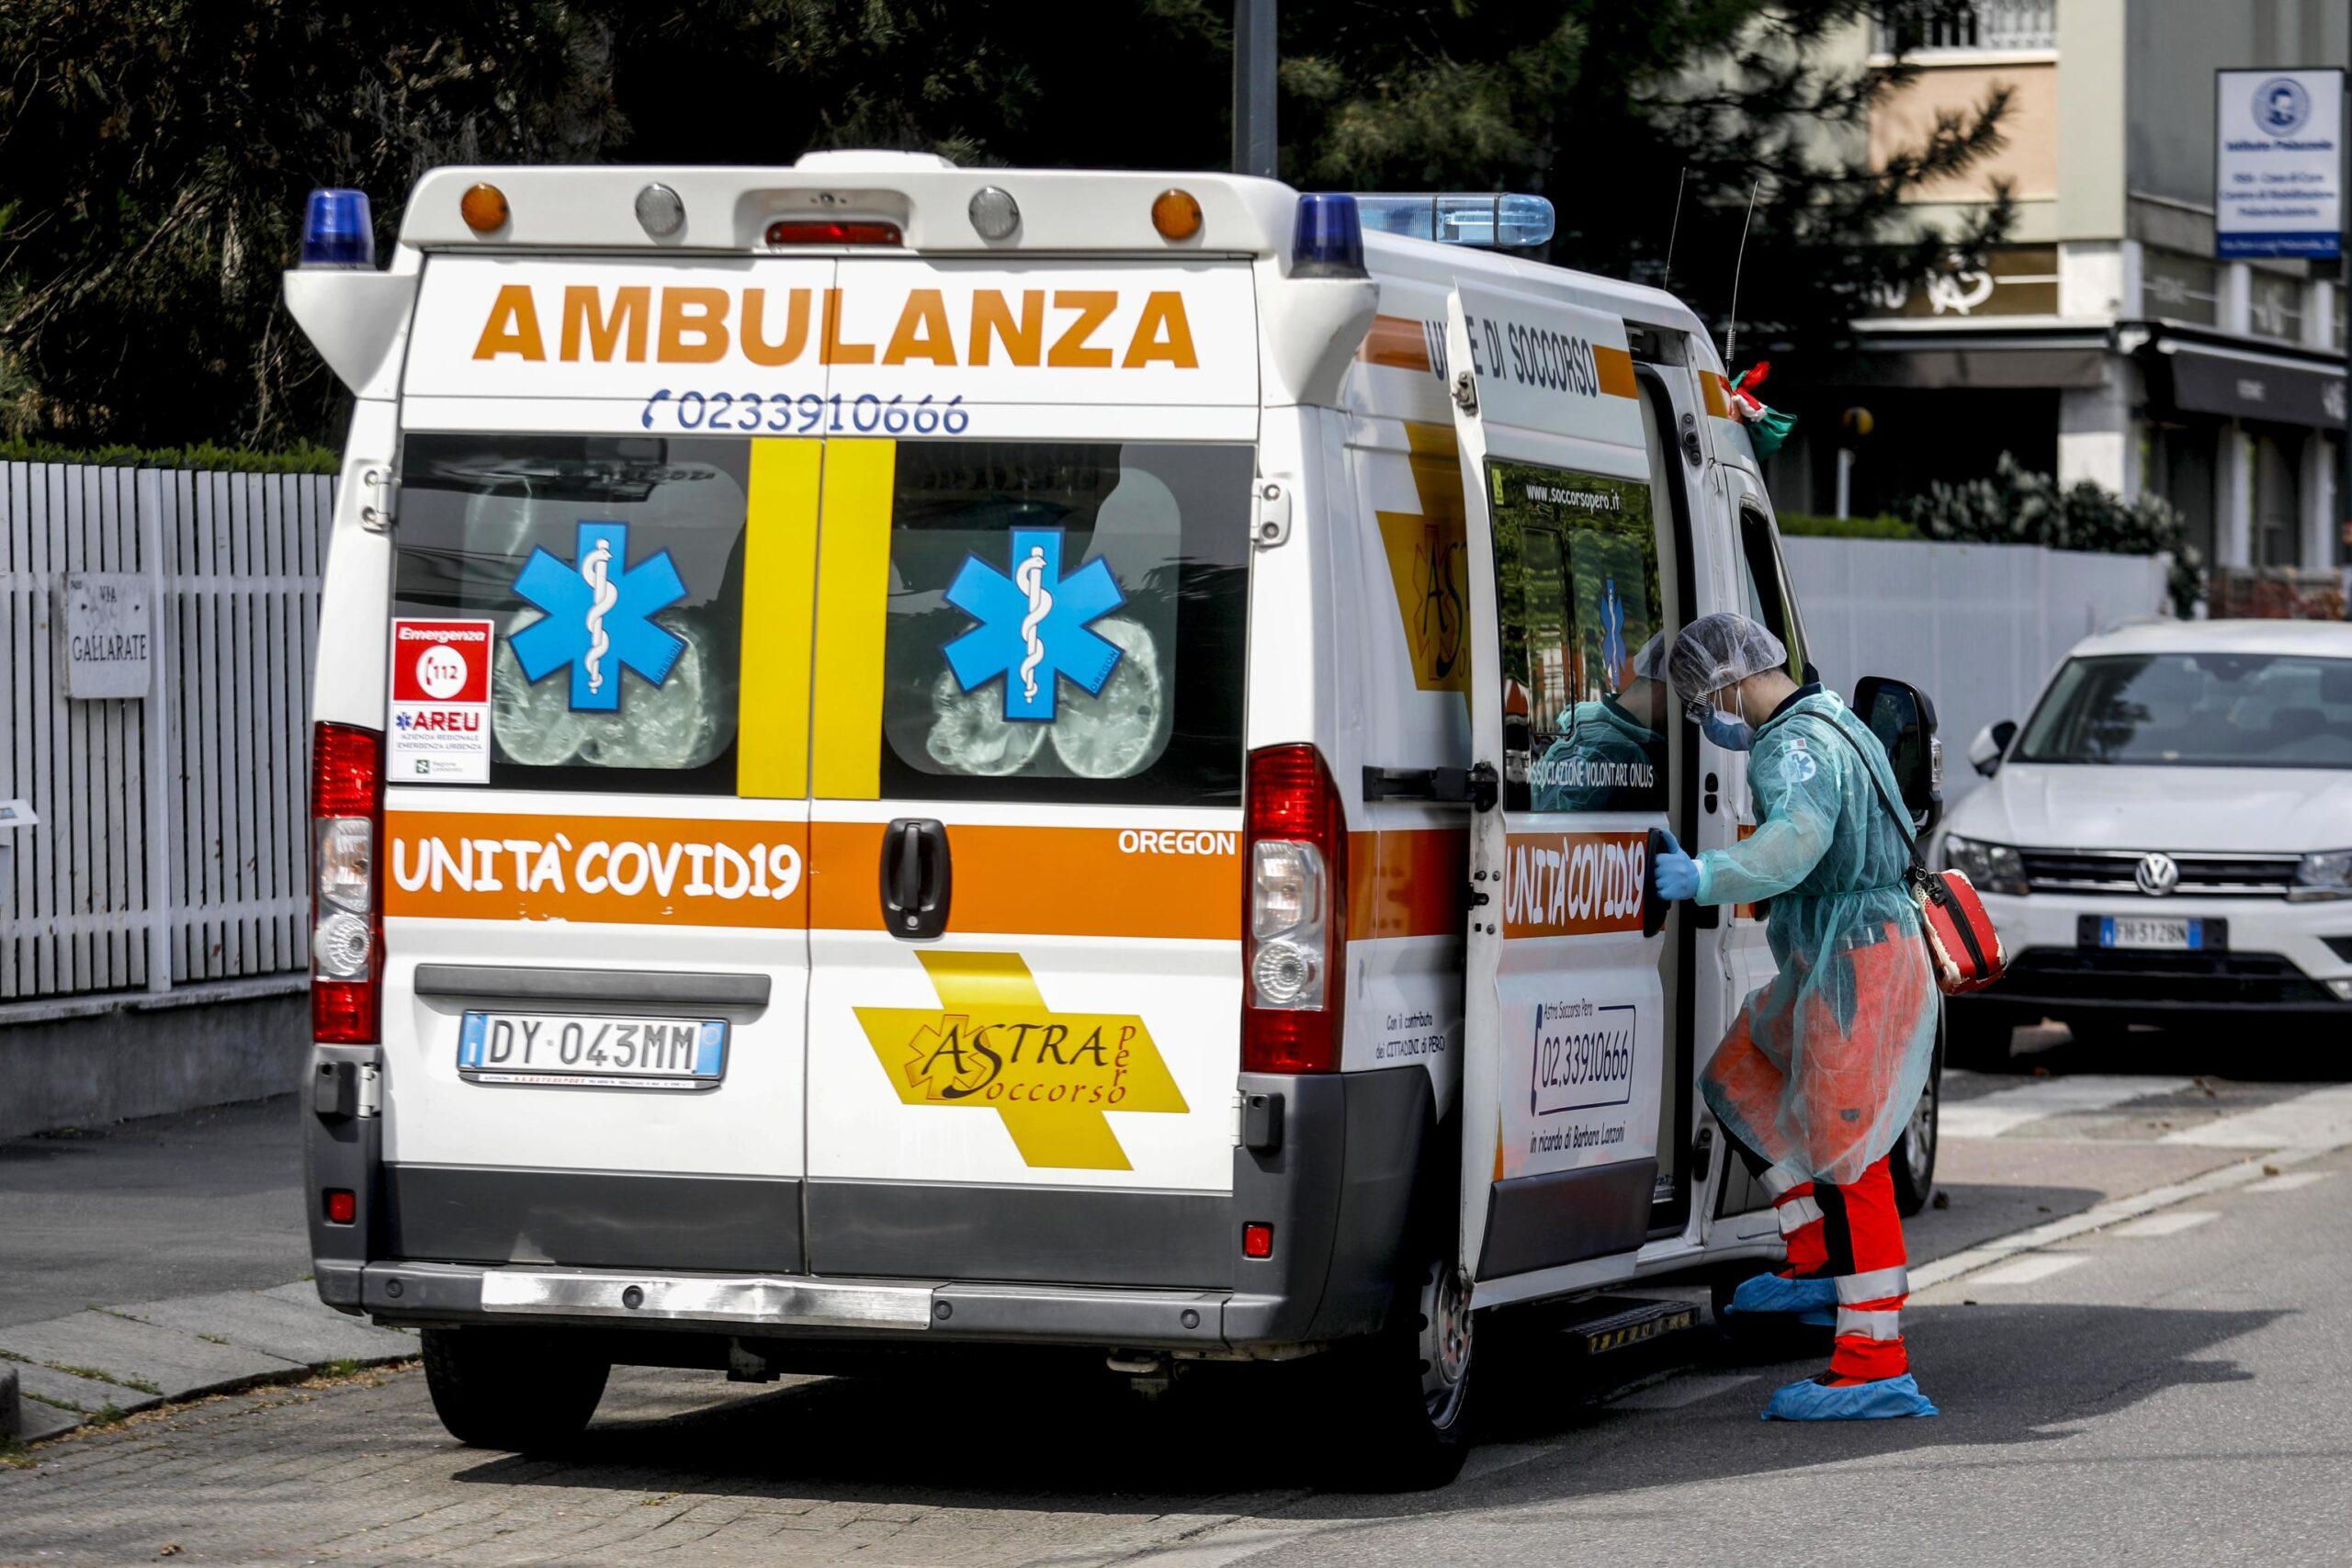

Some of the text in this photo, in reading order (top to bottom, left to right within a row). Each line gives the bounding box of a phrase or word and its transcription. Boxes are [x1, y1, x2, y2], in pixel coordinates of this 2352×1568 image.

[472, 285, 1199, 369] AMBULANZA
[1483, 319, 1507, 380] DI
[1508, 321, 1598, 399] SOCCORSO
[678, 390, 969, 434] 0233910666
[1525, 483, 1621, 514] www.soccorsopero.it
[99, 585, 118, 603] VIA
[73, 634, 147, 661] GALLARATE
[398, 626, 486, 643] Emergenza
[434, 665, 458, 680] 112
[1090, 649, 1119, 693] OREGON
[413, 712, 481, 732] AREU
[1586, 761, 1628, 787] VOLONTARI
[1630, 762, 1654, 788] ONLUS
[1118, 830, 1236, 855] OREGON
[392, 832, 802, 900] UNITÀ COVID19
[1567, 840, 1645, 919] COVID19
[490, 1020, 695, 1070] DY 043MM
[922, 1023, 1108, 1099] ASTRA
[1537, 1126, 1563, 1153] ricordo
[1564, 1125, 1572, 1150] di
